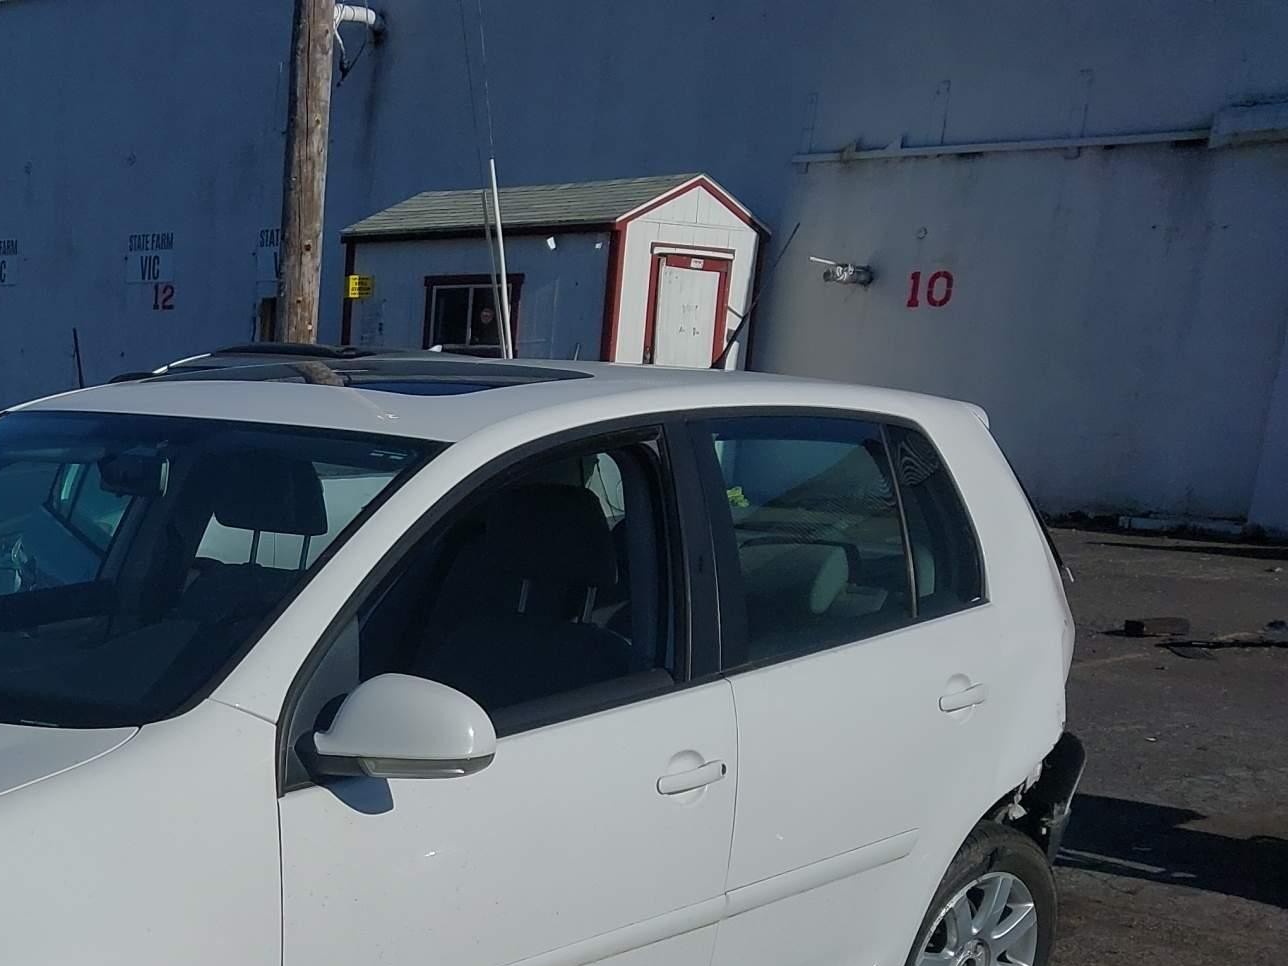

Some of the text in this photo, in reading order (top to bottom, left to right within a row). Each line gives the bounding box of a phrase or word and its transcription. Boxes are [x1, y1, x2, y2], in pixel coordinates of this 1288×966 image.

[129, 232, 174, 251] STATE FARM
[260, 229, 281, 247] STAT
[140, 255, 160, 281] VIC
[152, 284, 175, 310] 12
[906, 271, 954, 307] 10
